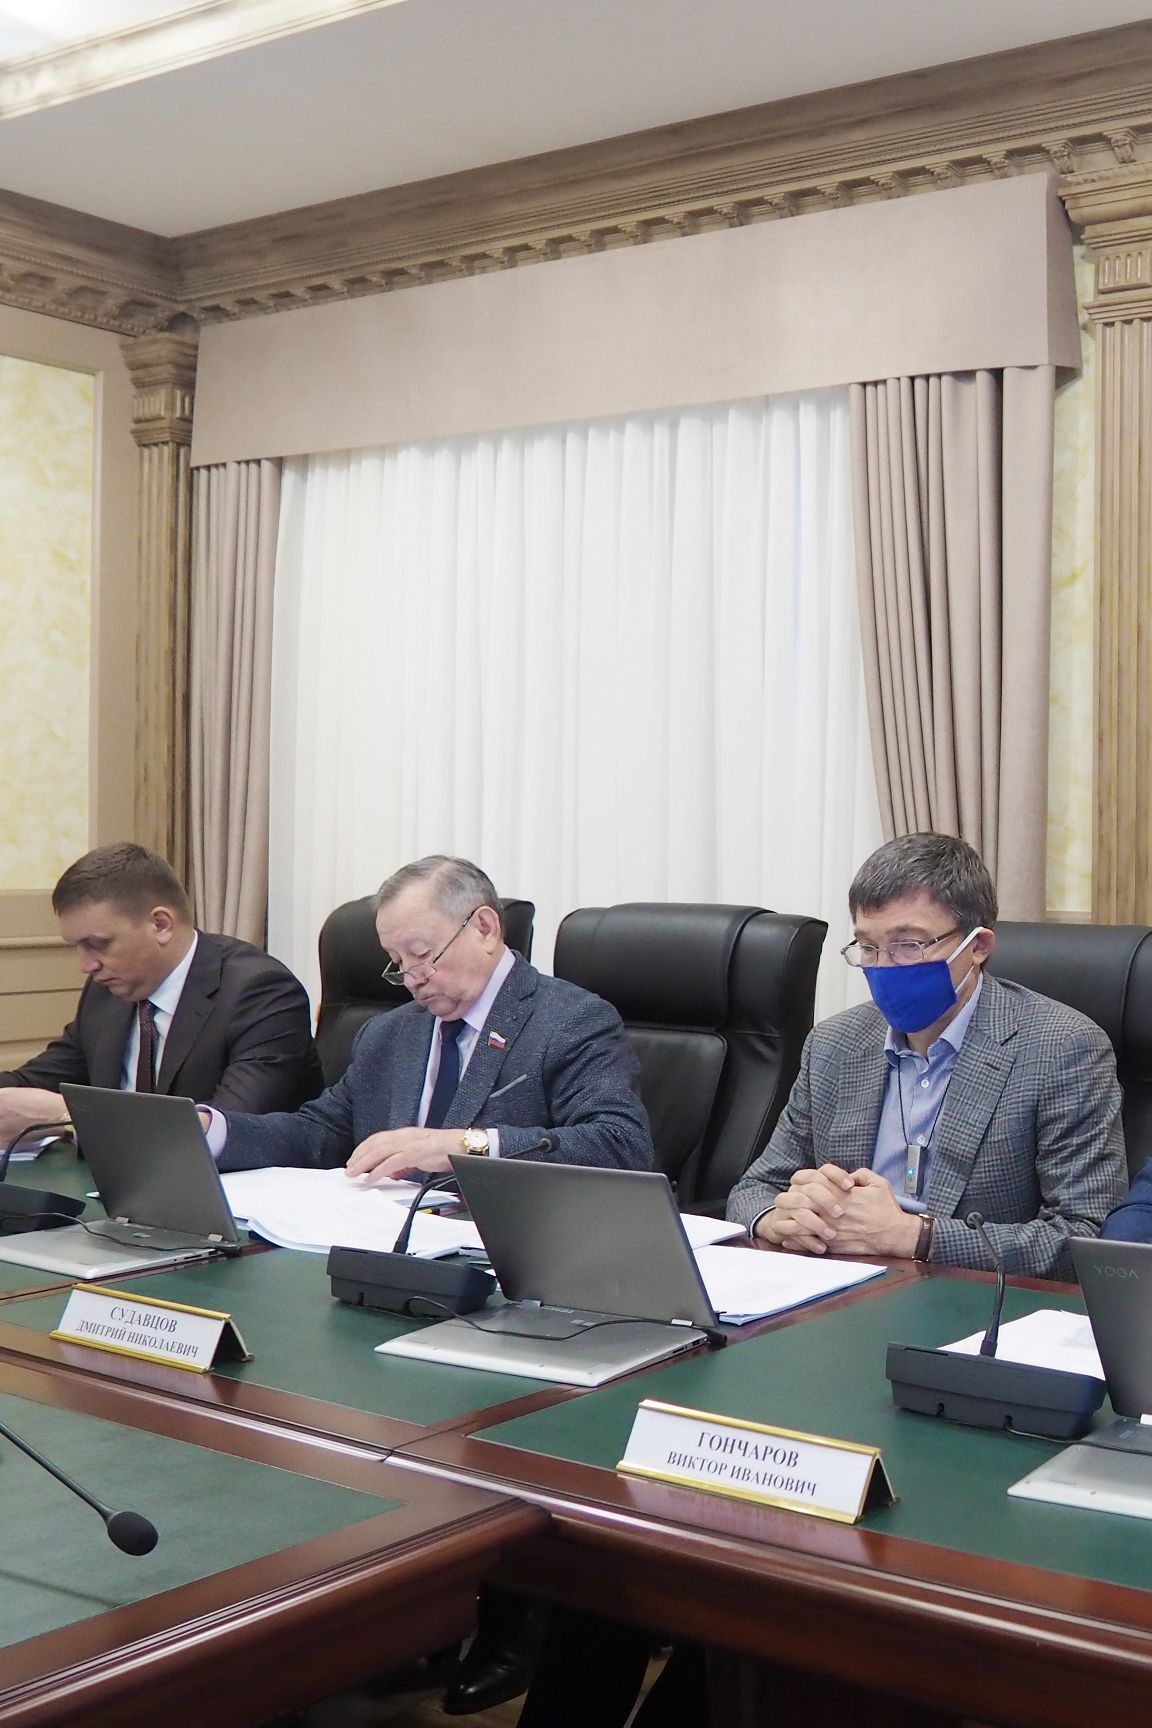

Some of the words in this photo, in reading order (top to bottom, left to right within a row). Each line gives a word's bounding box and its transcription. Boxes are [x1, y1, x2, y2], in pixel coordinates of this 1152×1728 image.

[1092, 1264, 1141, 1280] YOGA
[110, 1306, 178, 1333] СУДАВЦОВ
[75, 1319, 126, 1341] ДМИТРИЙ
[127, 1331, 199, 1358] НИКОЛАЕВИЧ
[697, 1431, 800, 1468] ГОНЧАРОВ
[667, 1451, 728, 1476] ВИКТОР
[729, 1465, 817, 1497] ИВАНОВИЧ
